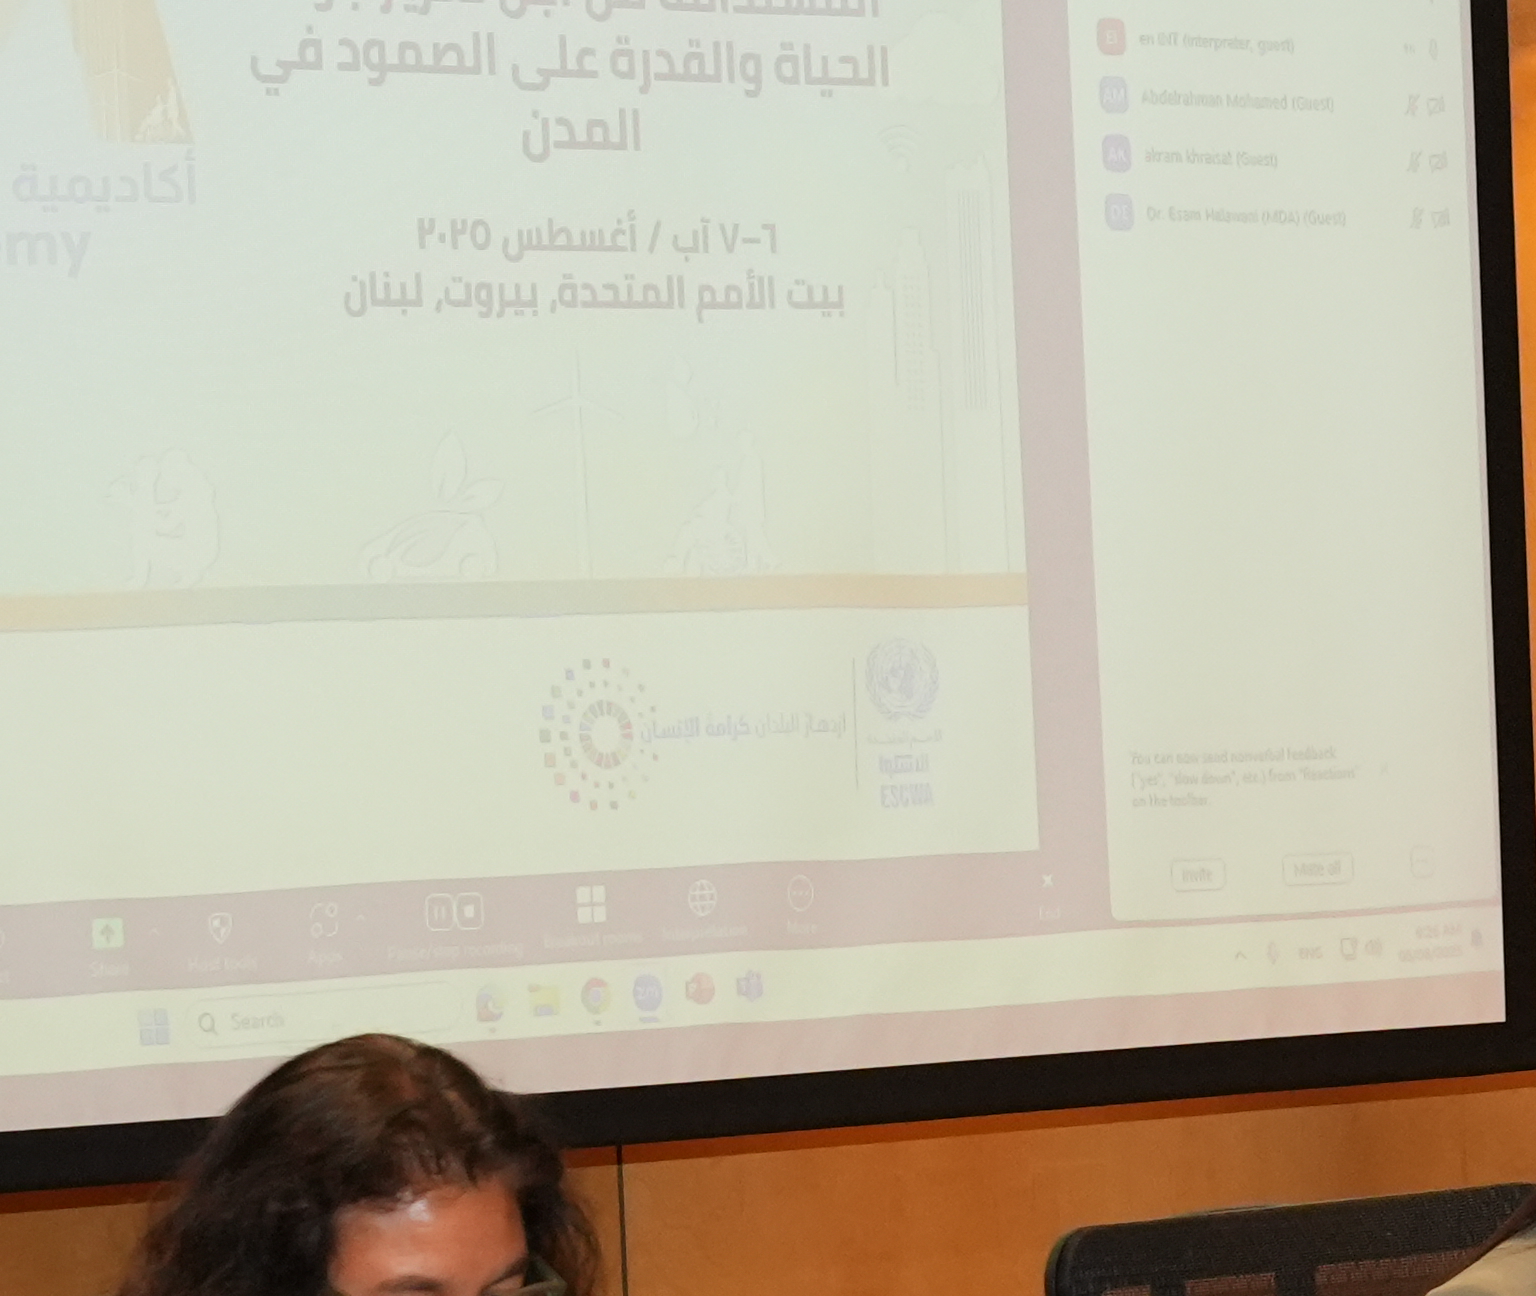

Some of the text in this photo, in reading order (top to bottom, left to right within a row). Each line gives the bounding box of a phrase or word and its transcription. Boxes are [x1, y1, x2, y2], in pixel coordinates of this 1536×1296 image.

[250, 25, 889, 98] الحياة والقدرة على الصمود في
[522, 107, 641, 163] المدن
[12, 147, 197, 214] أكاديمية
[3, 231, 92, 280] my
[502, 210, 638, 262] أغسطس
[343, 272, 423, 317] لبنان
[697, 269, 775, 323] الأمم
[786, 277, 846, 319] بيت
